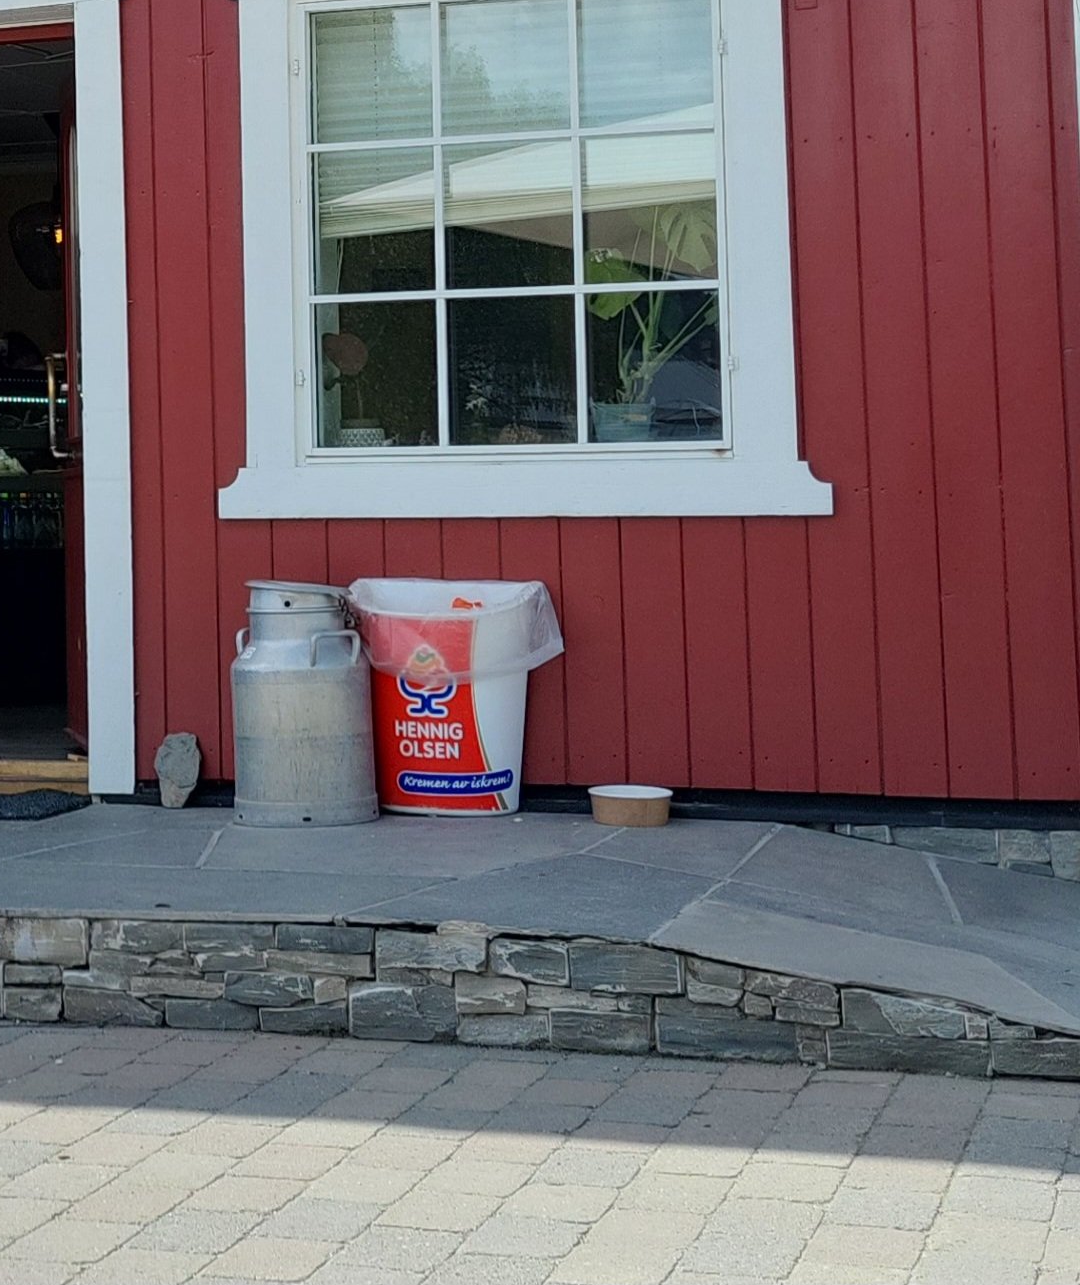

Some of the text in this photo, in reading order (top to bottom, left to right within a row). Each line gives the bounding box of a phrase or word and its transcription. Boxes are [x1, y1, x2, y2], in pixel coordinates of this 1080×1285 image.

[395, 720, 463, 740] HENNIG
[400, 739, 459, 759] OLSEN
[404, 773, 511, 789] Kremen av iskrem!
